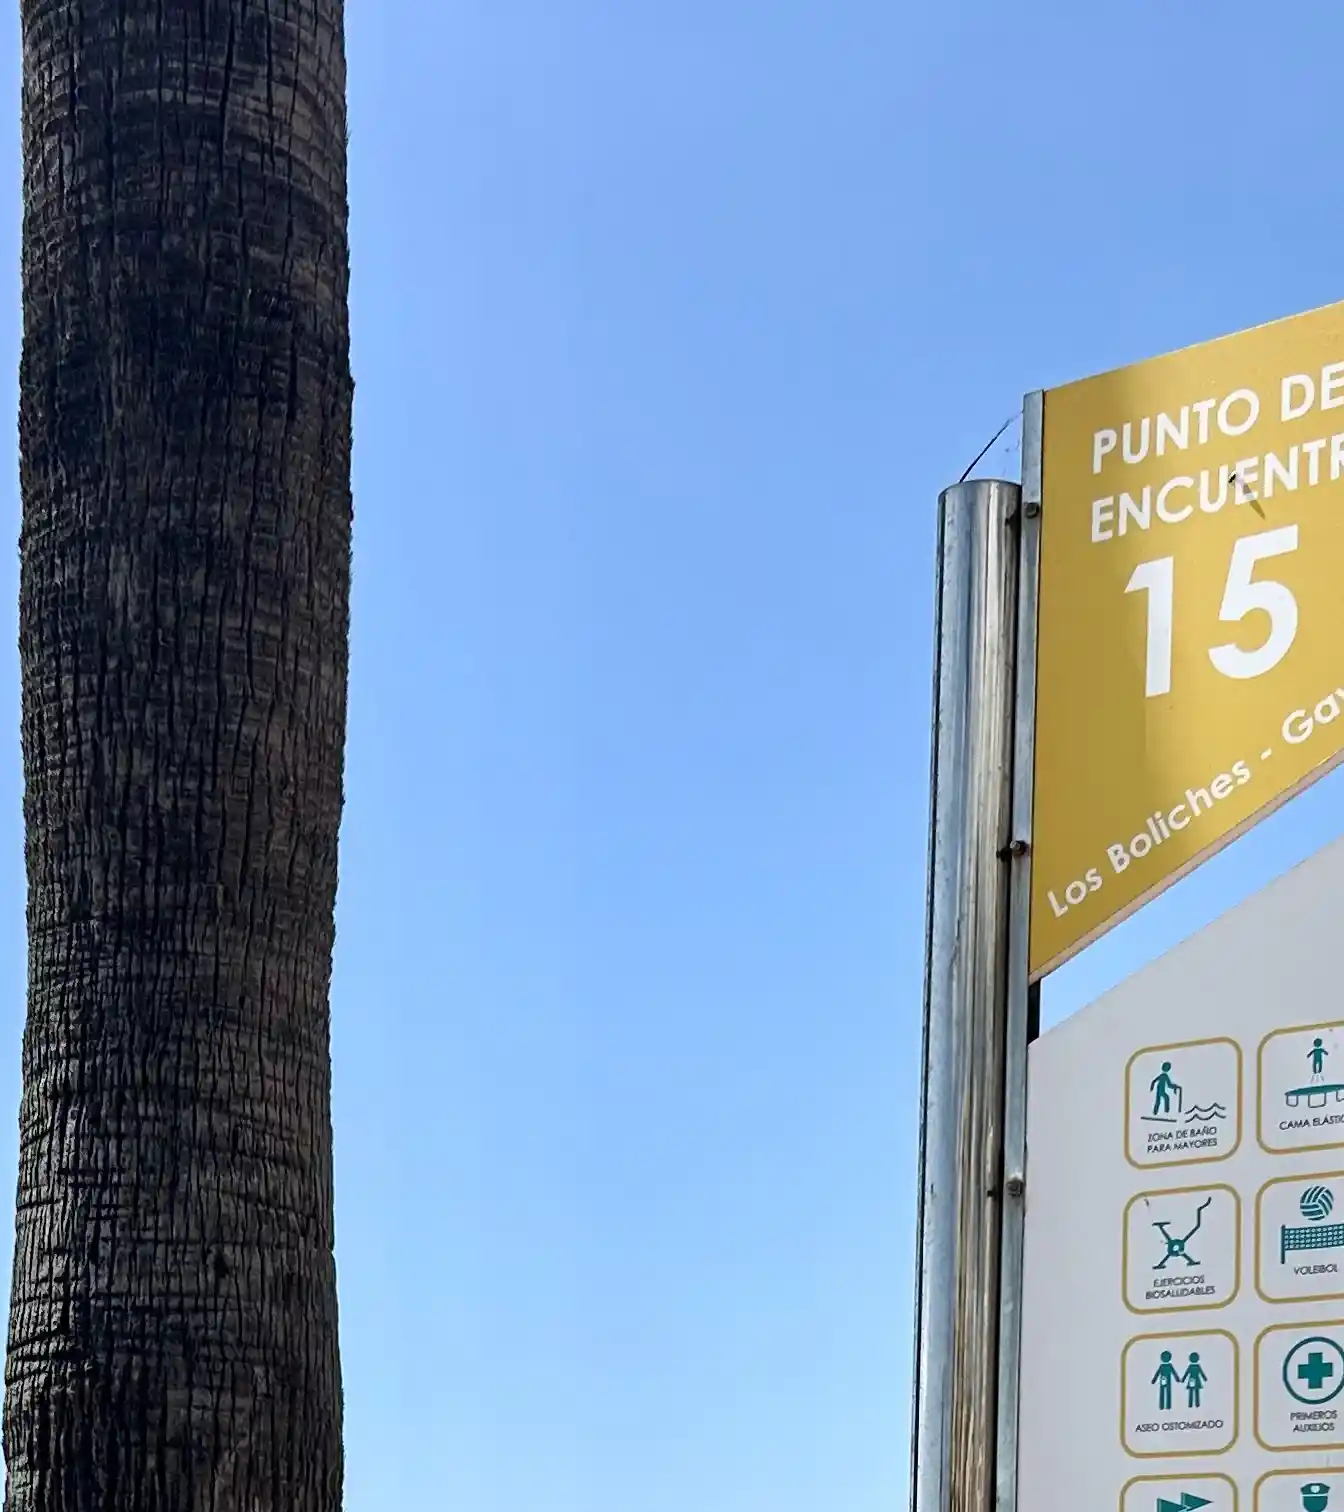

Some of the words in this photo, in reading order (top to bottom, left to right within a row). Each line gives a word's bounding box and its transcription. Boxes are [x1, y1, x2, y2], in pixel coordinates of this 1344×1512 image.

[1092, 388, 1260, 474] PUNTO
[1123, 524, 1299, 698] 15
[1047, 865, 1104, 918] Los
[1107, 758, 1252, 875] Boliches
[1279, 1118, 1310, 1131] CAMA
[1147, 1131, 1174, 1144] ZONA
[1175, 1128, 1189, 1140] DE
[1189, 1125, 1218, 1138] BAÑO
[1146, 1142, 1172, 1154] PARA
[1172, 1137, 1218, 1151] MAYORES
[1153, 1274, 1206, 1288] EJERCICIOS
[1145, 1285, 1217, 1301] BIOSALUDABLES
[1289, 1409, 1339, 1422] PRIMEROS
[1135, 1422, 1160, 1433] ASEO
[1161, 1418, 1225, 1432] OSTOMIZADO
[1292, 1421, 1336, 1433] AUXILIOS
